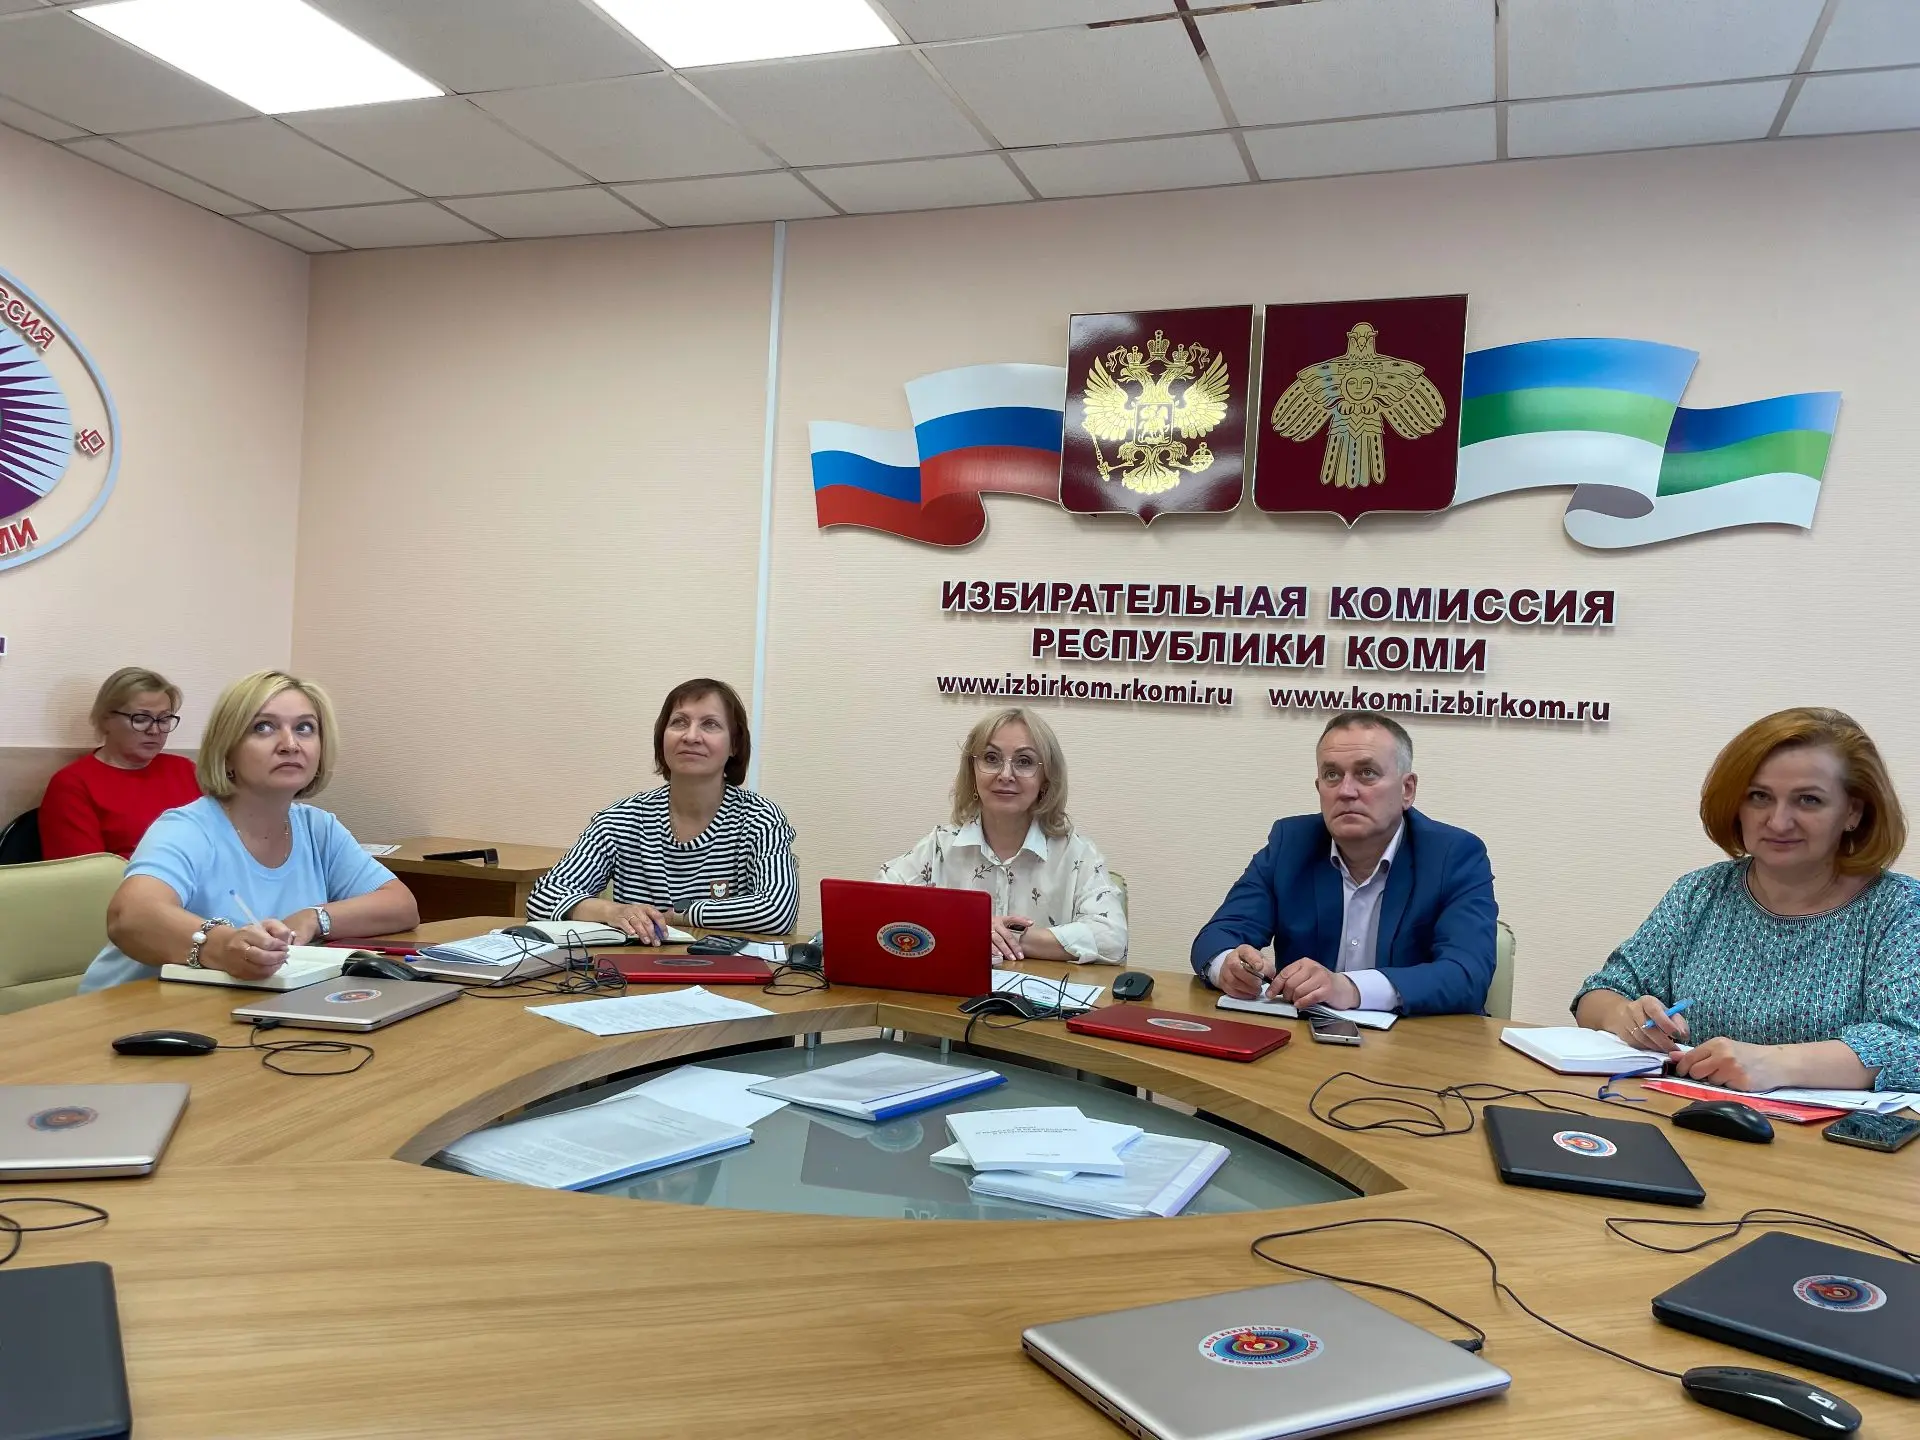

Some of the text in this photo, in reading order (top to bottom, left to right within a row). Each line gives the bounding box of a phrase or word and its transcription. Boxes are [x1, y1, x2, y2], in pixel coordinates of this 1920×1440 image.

[941, 581, 1615, 624] ИЗБИРАТЕЛЬНАЯ КОМИССИЯ
[1032, 627, 1487, 672] РЕСПУБЛИКИ КОМИ
[936, 672, 1611, 721] www.izbirkom.rkomi.ru www.komi.izbirkom.ru
